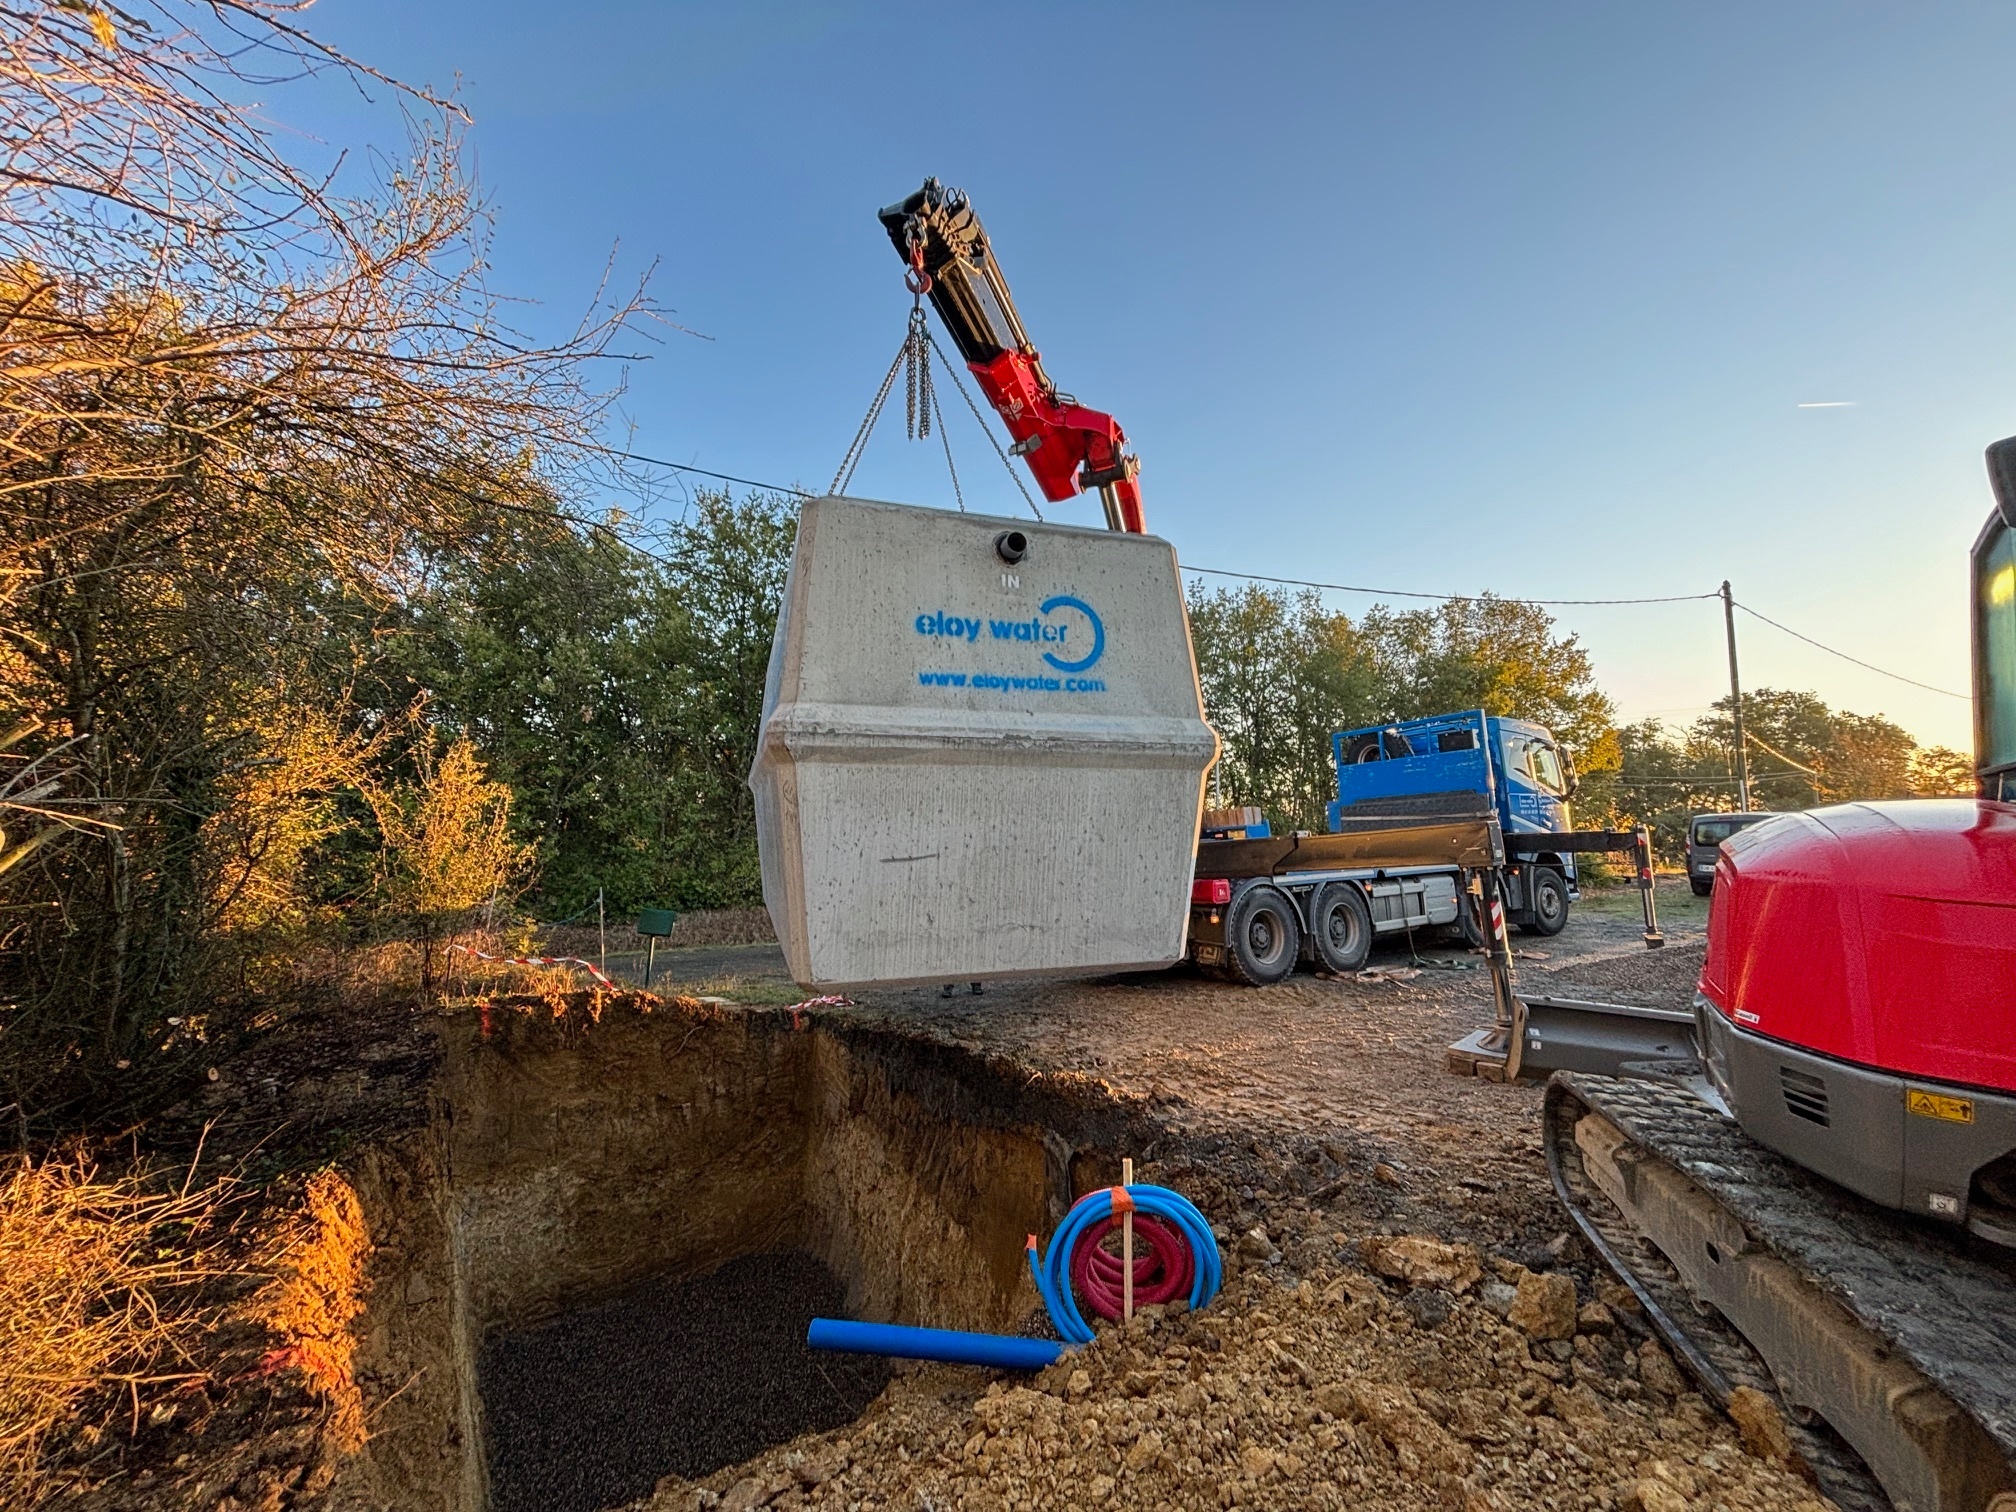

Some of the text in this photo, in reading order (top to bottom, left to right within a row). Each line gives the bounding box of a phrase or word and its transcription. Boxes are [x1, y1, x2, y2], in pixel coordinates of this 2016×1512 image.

[1001, 574, 1020, 589] IN
[915, 610, 1068, 643] eloy water
[918, 671, 1107, 694] www.eloywater.com
